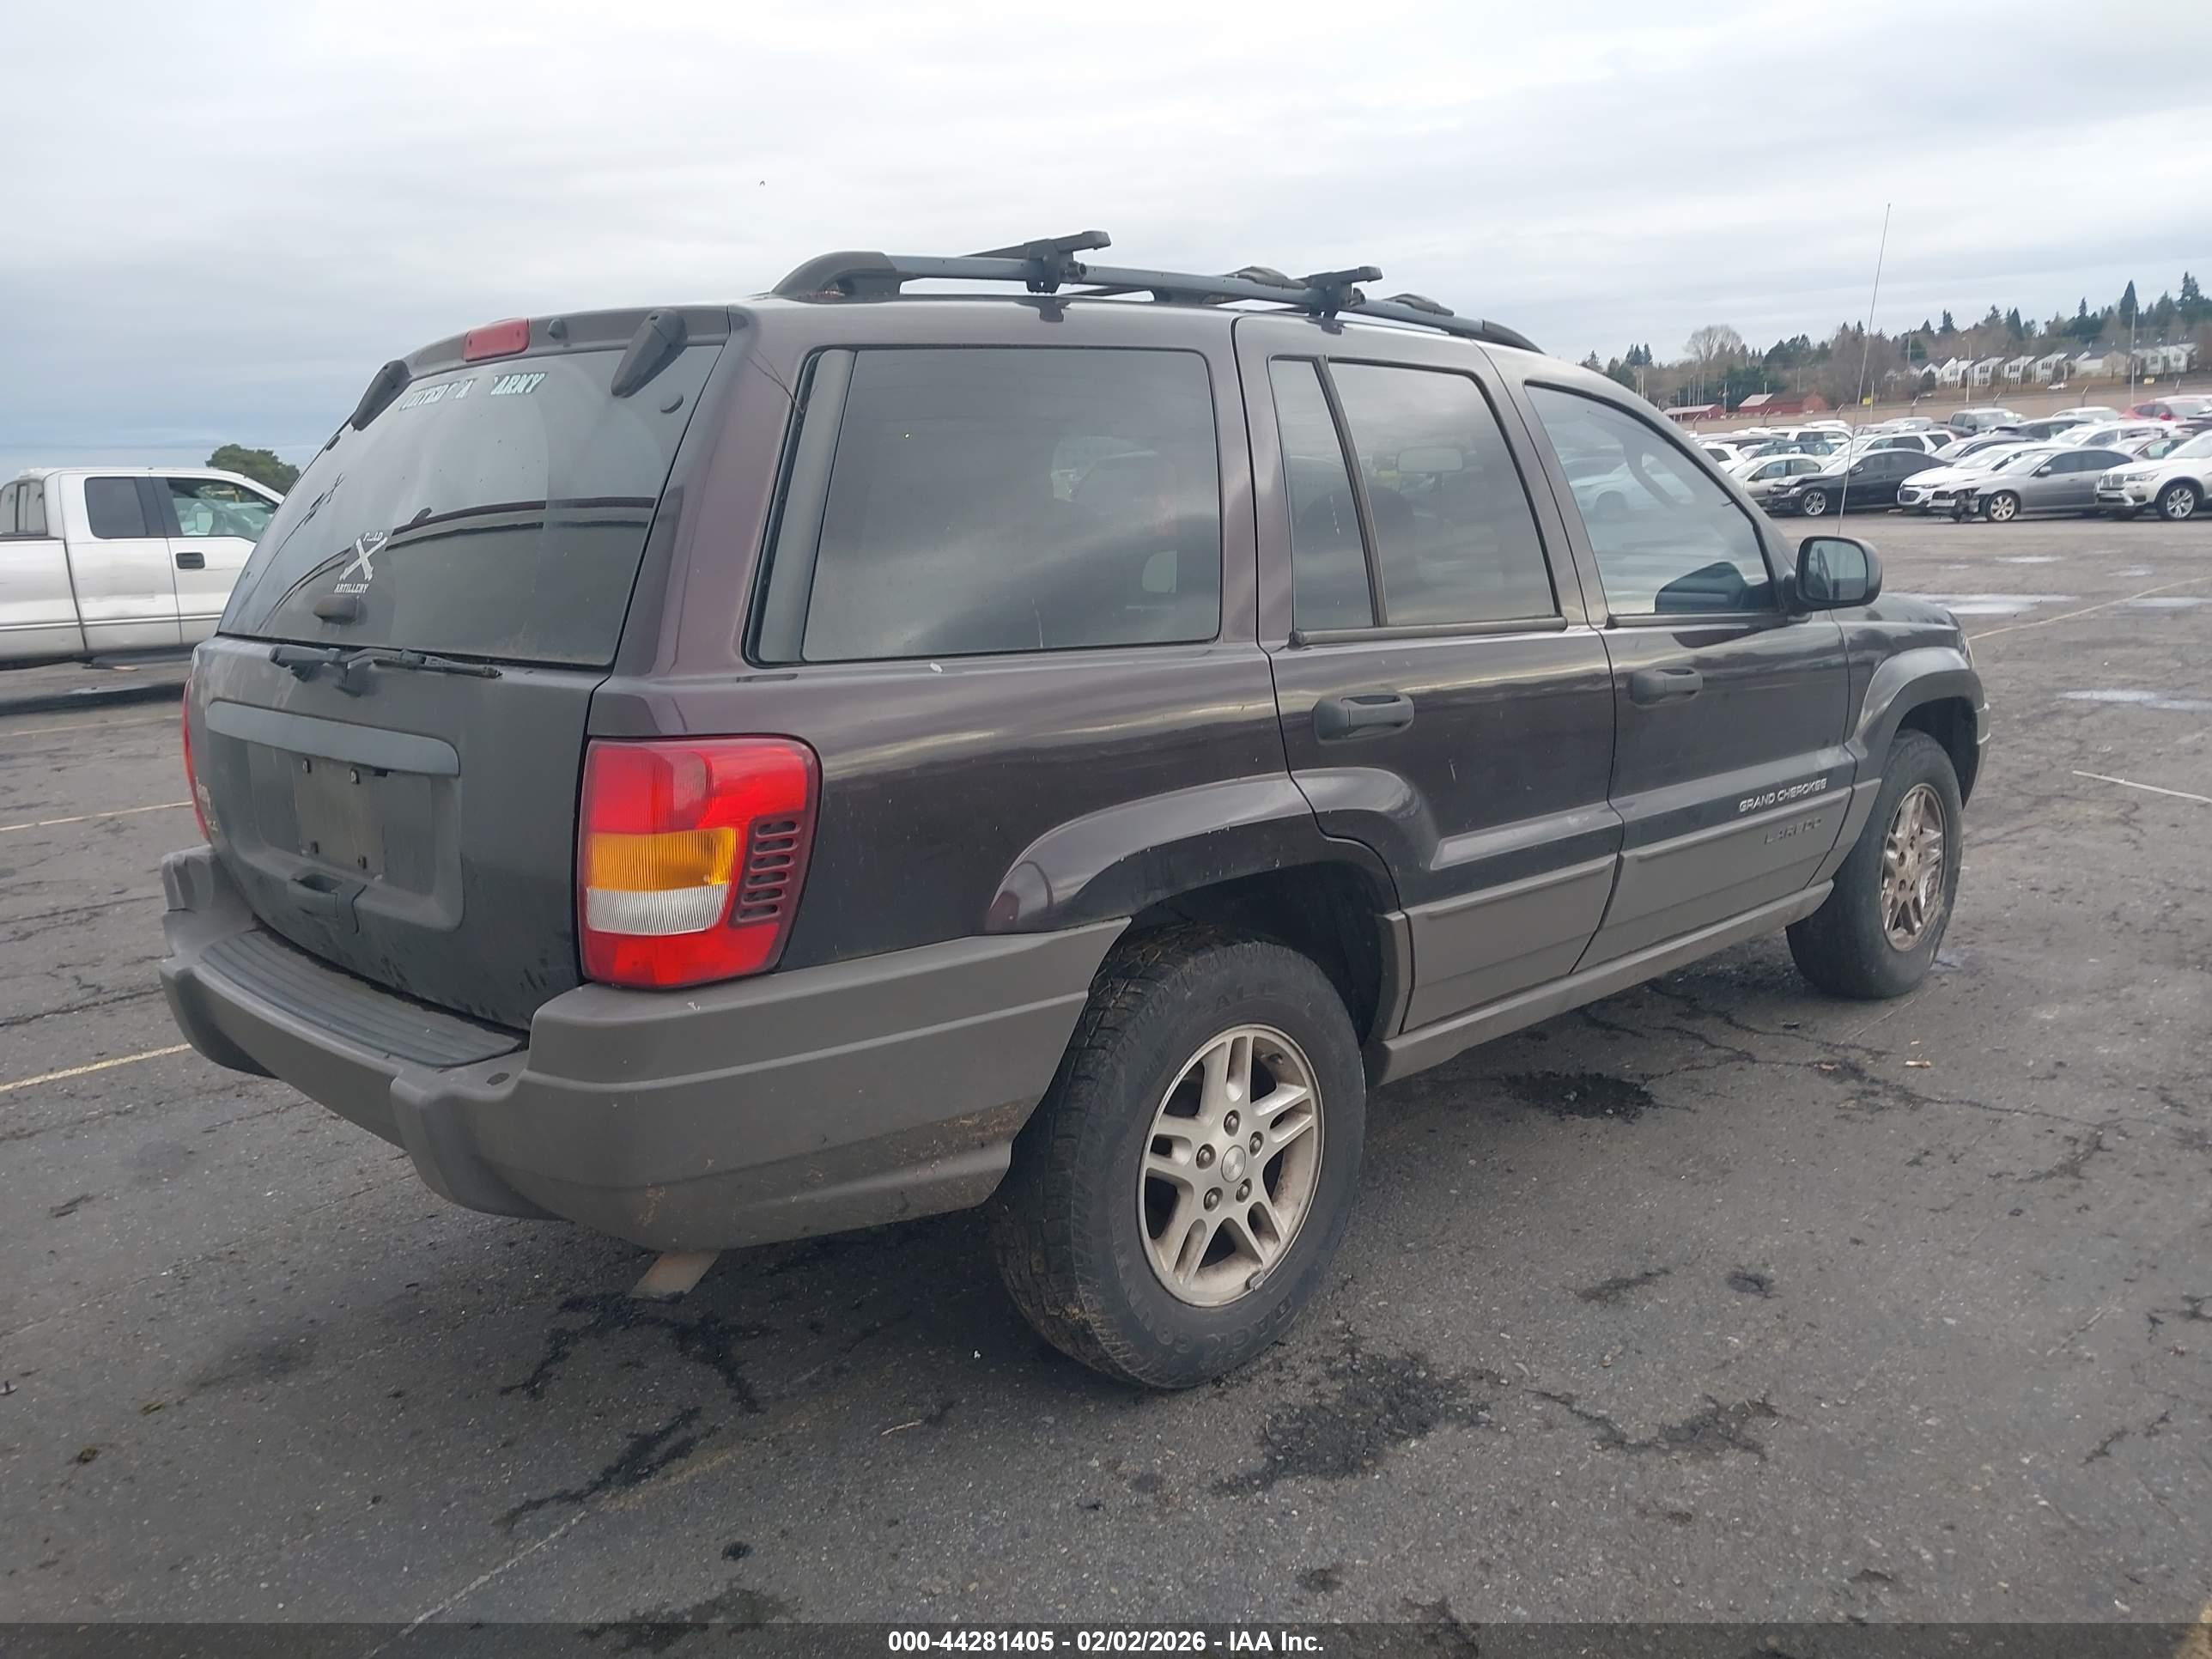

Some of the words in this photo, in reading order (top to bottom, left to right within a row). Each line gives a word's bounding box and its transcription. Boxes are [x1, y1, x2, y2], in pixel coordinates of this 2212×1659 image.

[493, 373, 547, 395] ARMY
[1739, 792, 1775, 812] GRAND
[1778, 778, 1827, 802] CHEROKEE
